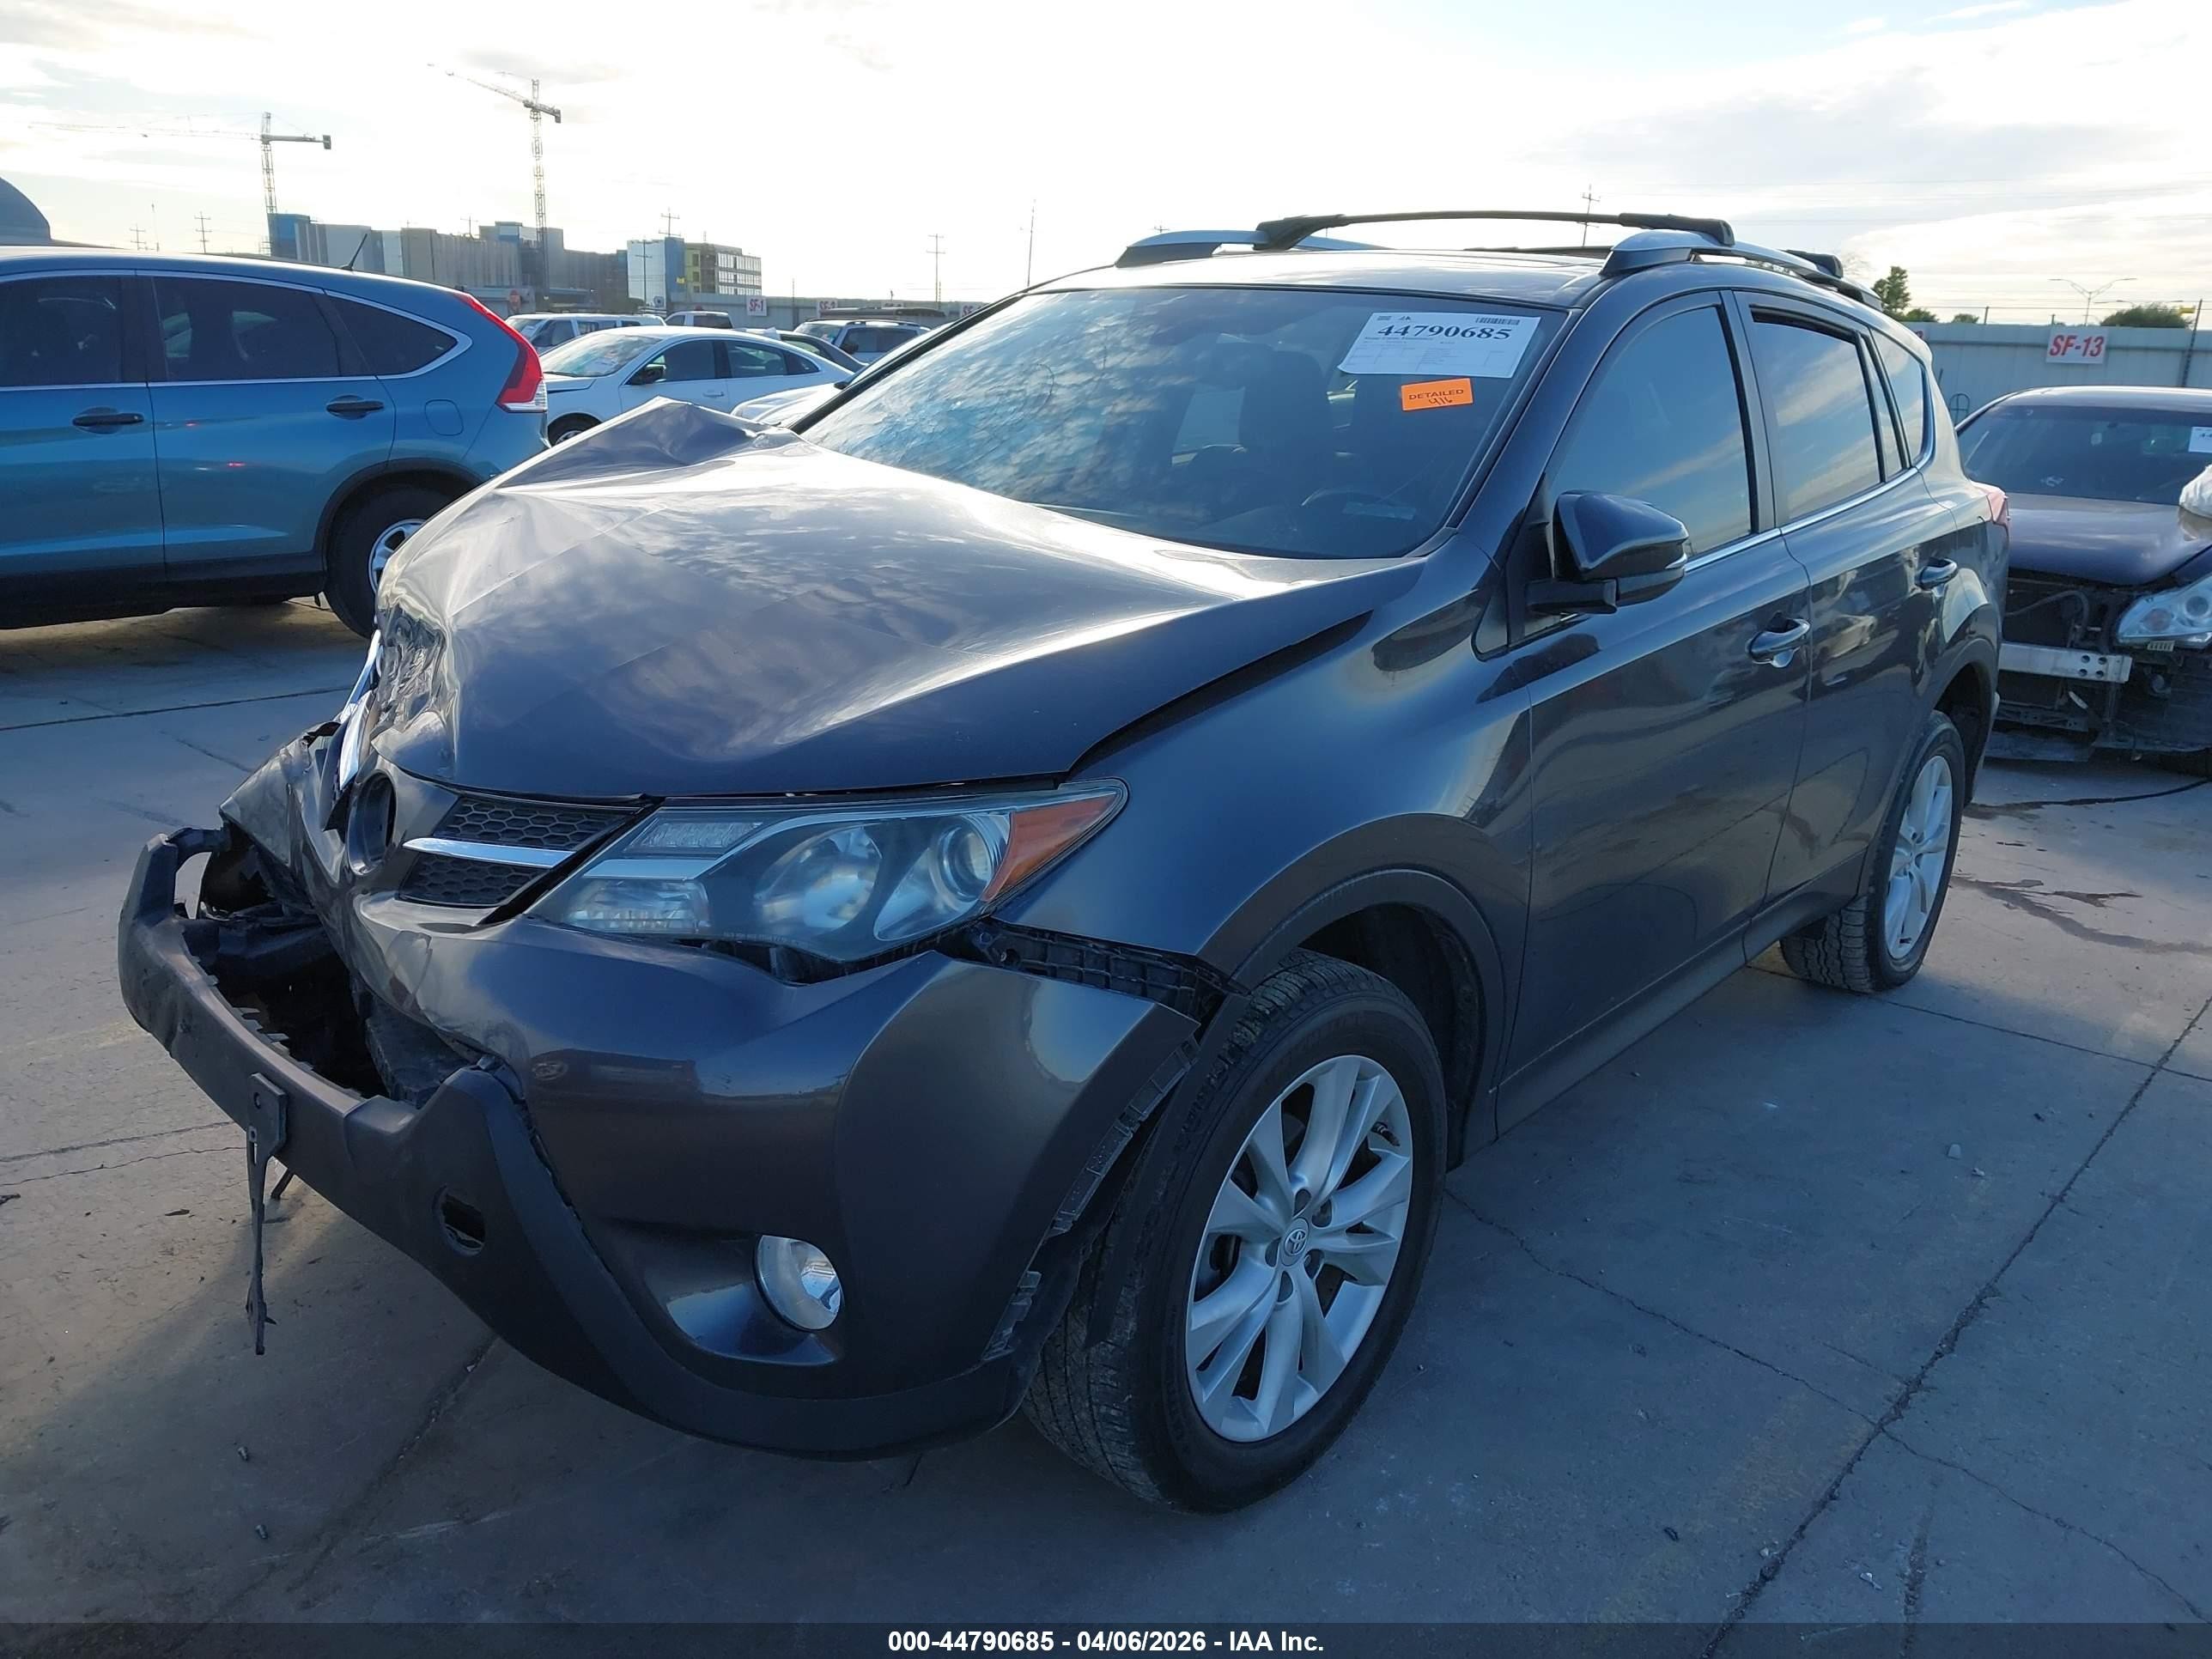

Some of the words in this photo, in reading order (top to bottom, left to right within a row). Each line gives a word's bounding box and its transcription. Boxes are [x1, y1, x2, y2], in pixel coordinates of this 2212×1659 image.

[749, 298, 763, 312] SF-1
[1377, 324, 1513, 340] 44790685
[2049, 334, 2106, 357] SF-13
[1408, 389, 1464, 401] DETAILED
